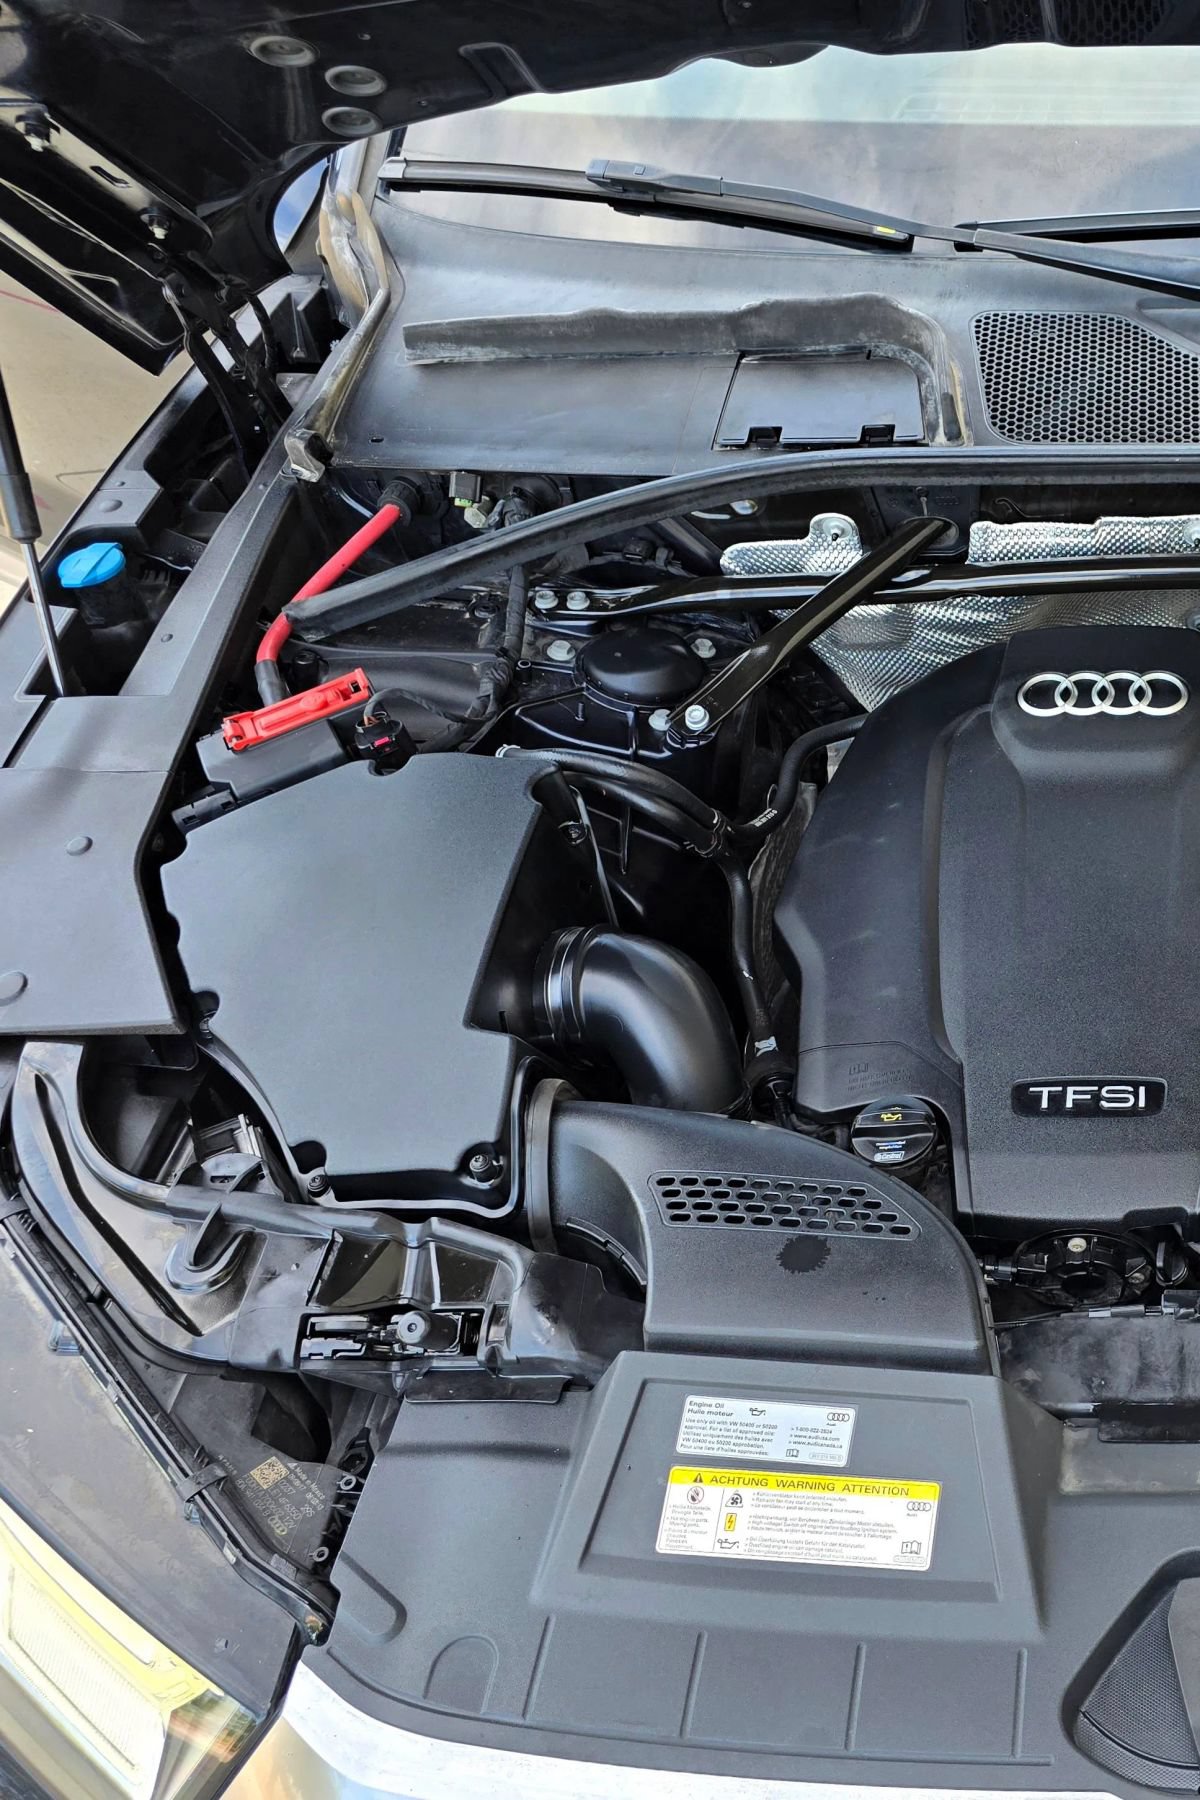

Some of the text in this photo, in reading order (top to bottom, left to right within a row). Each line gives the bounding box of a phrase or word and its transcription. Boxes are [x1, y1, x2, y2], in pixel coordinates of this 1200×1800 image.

[1029, 1085, 1146, 1110] TFSI
[688, 1400, 712, 1408] Engine
[295, 1467, 307, 1481] Made
[311, 1482, 326, 1500] Mexico
[709, 1474, 910, 1496] ACHTUNG WARNING ATTENTION
